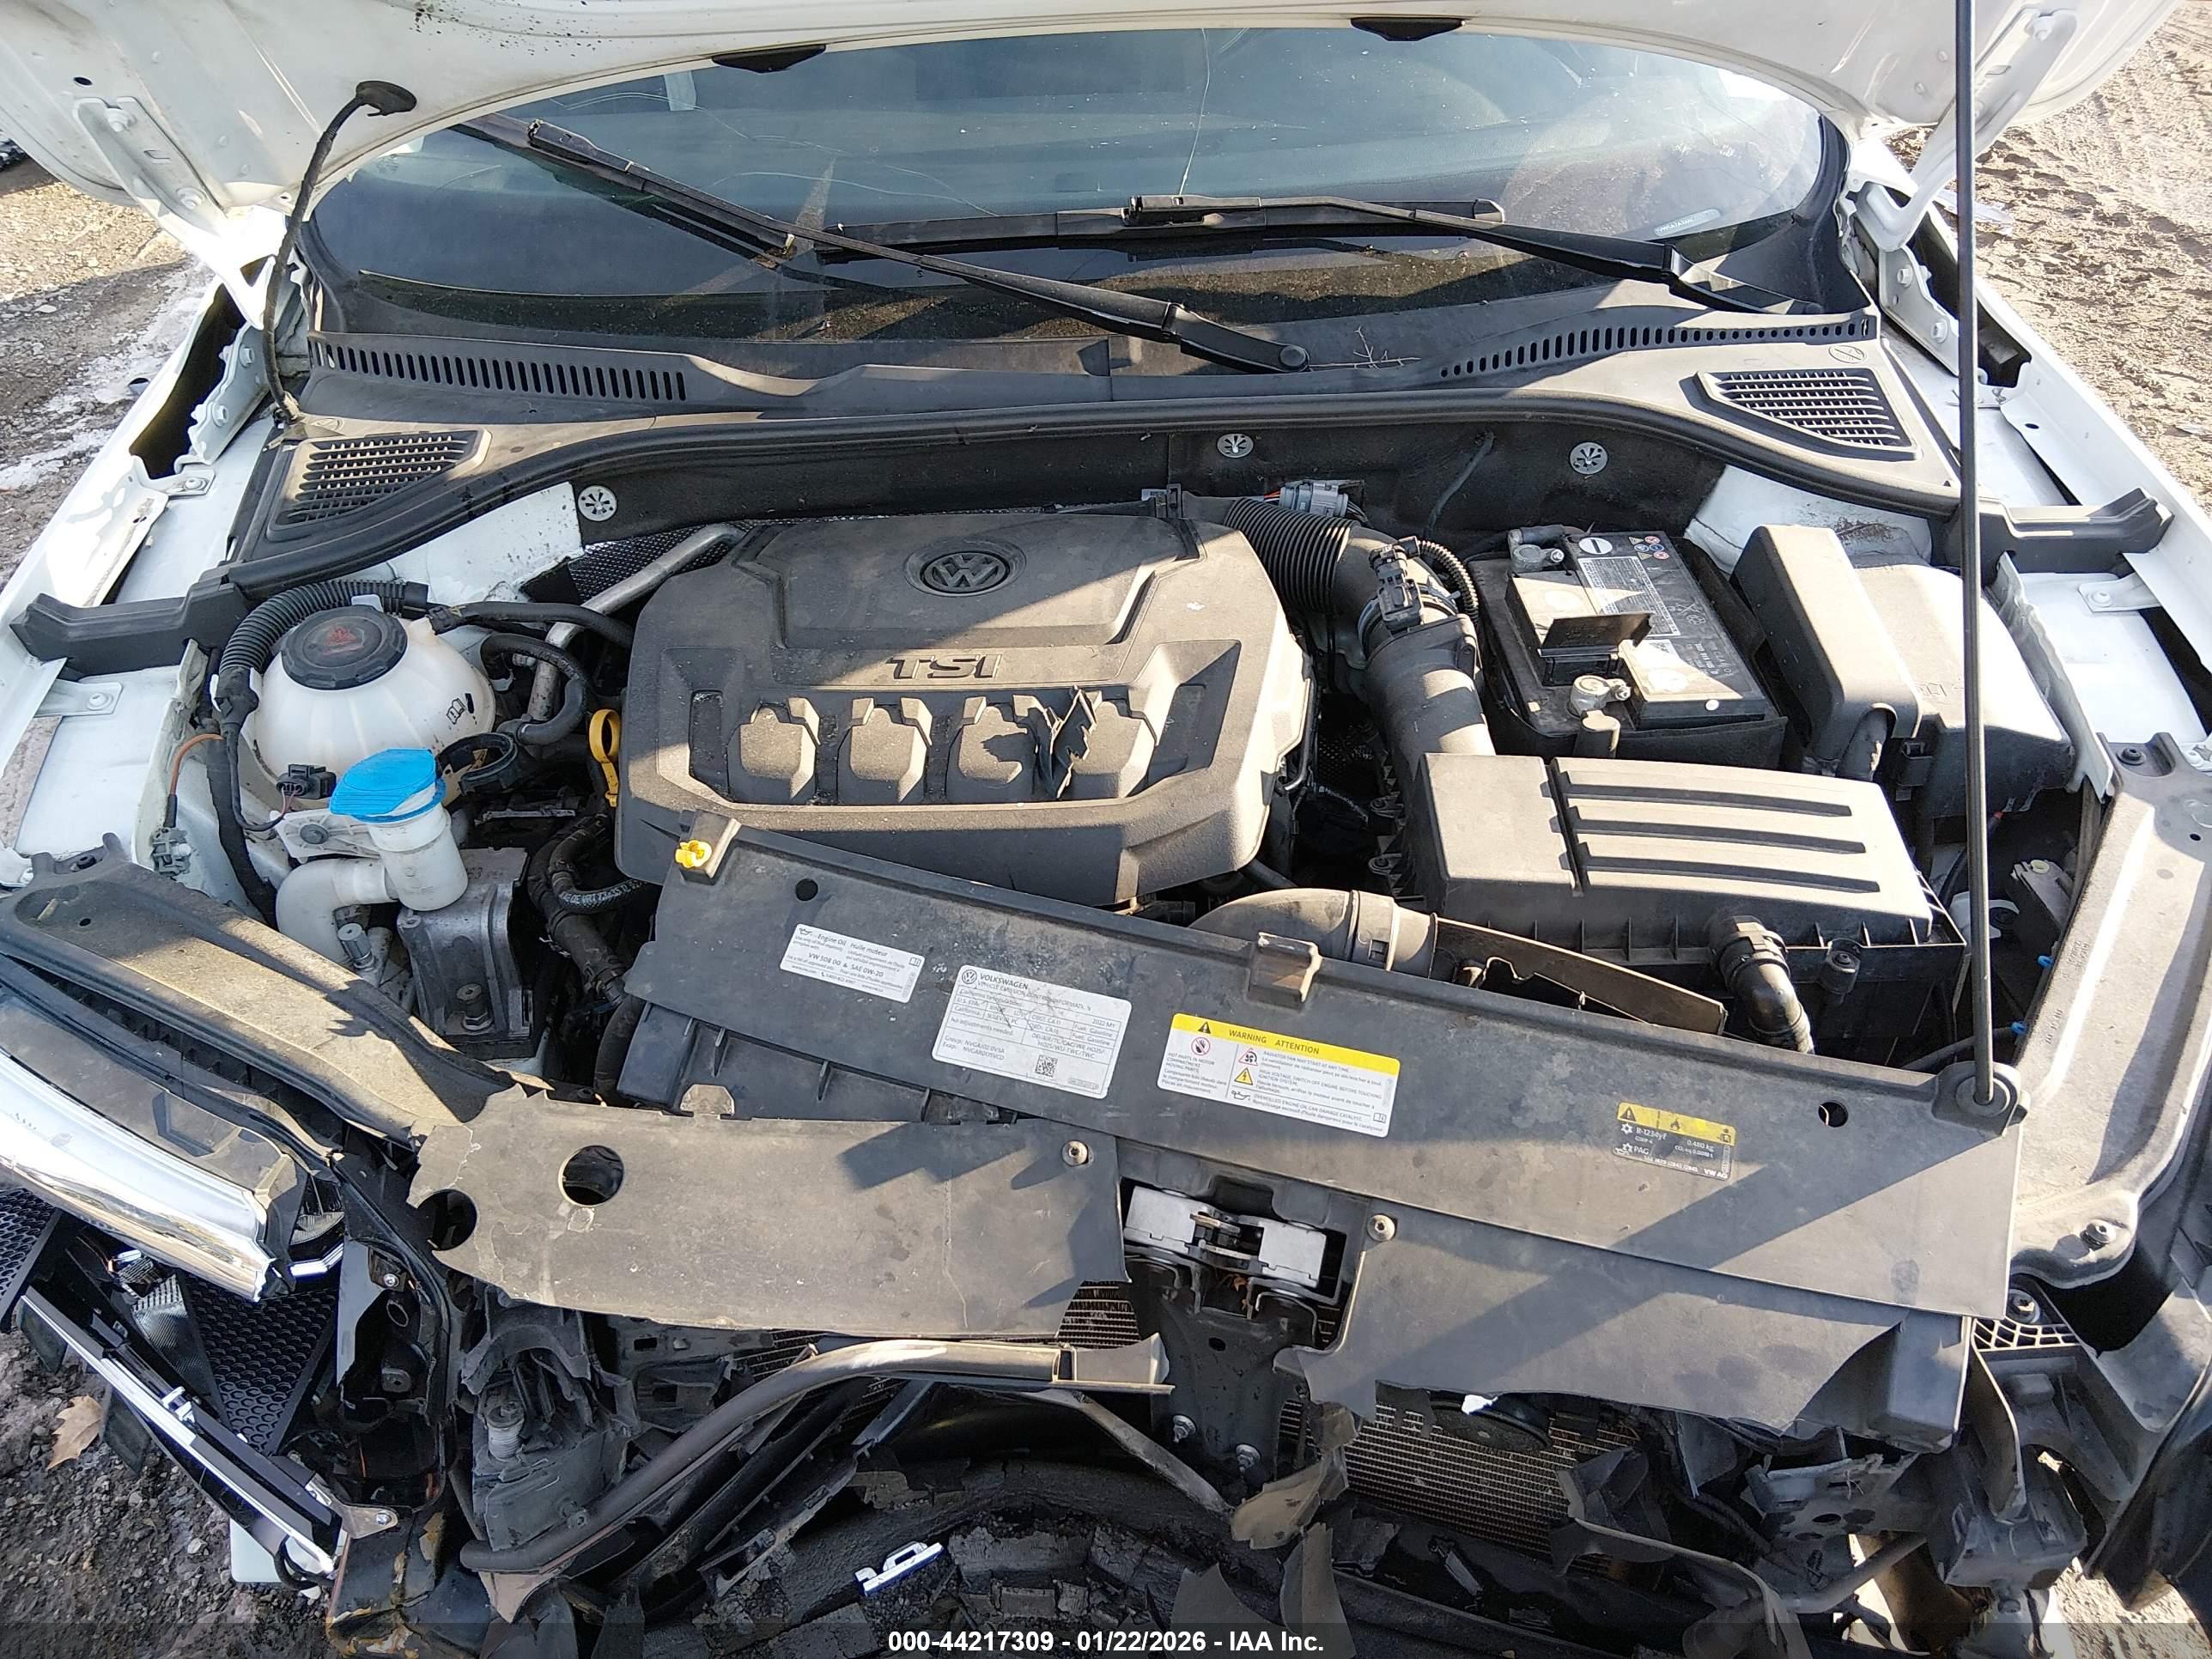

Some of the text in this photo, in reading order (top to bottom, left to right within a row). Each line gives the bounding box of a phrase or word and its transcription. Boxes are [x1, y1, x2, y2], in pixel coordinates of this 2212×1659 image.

[886, 653, 1002, 680] TSI
[817, 933, 837, 943] Engine
[850, 942, 866, 951] Huile
[866, 946, 888, 957] moteur
[862, 967, 884, 977] 0W-20
[979, 973, 1029, 989] VOLKSWAGEN
[960, 1018, 993, 1030] adjustments
[1089, 1027, 1113, 1037] Gasoline
[945, 1035, 963, 1044] Group:
[1086, 1036, 1110, 1046] Gasoline
[1228, 1030, 1319, 1054] WARNING ATTENTION
[1633, 1146, 1649, 1155] PAG
